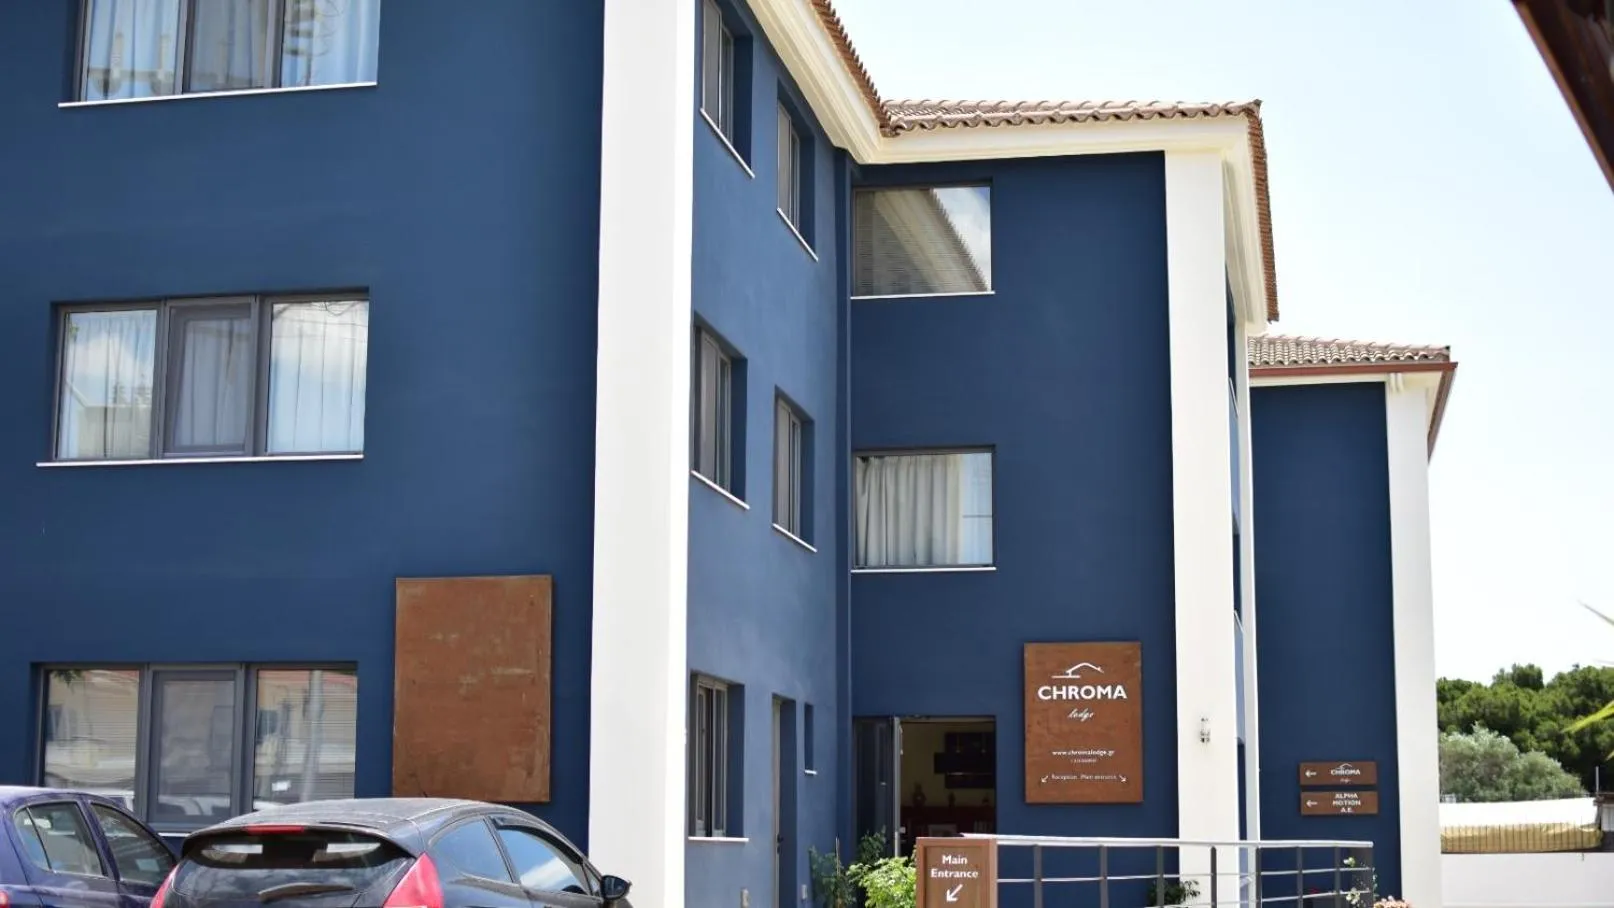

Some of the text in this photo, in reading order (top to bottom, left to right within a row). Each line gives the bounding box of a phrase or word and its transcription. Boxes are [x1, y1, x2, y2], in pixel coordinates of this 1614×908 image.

[1037, 685, 1127, 700] CHROMA
[1067, 708, 1095, 722] lodge
[942, 854, 968, 865] Main
[930, 868, 979, 878] Entrance
